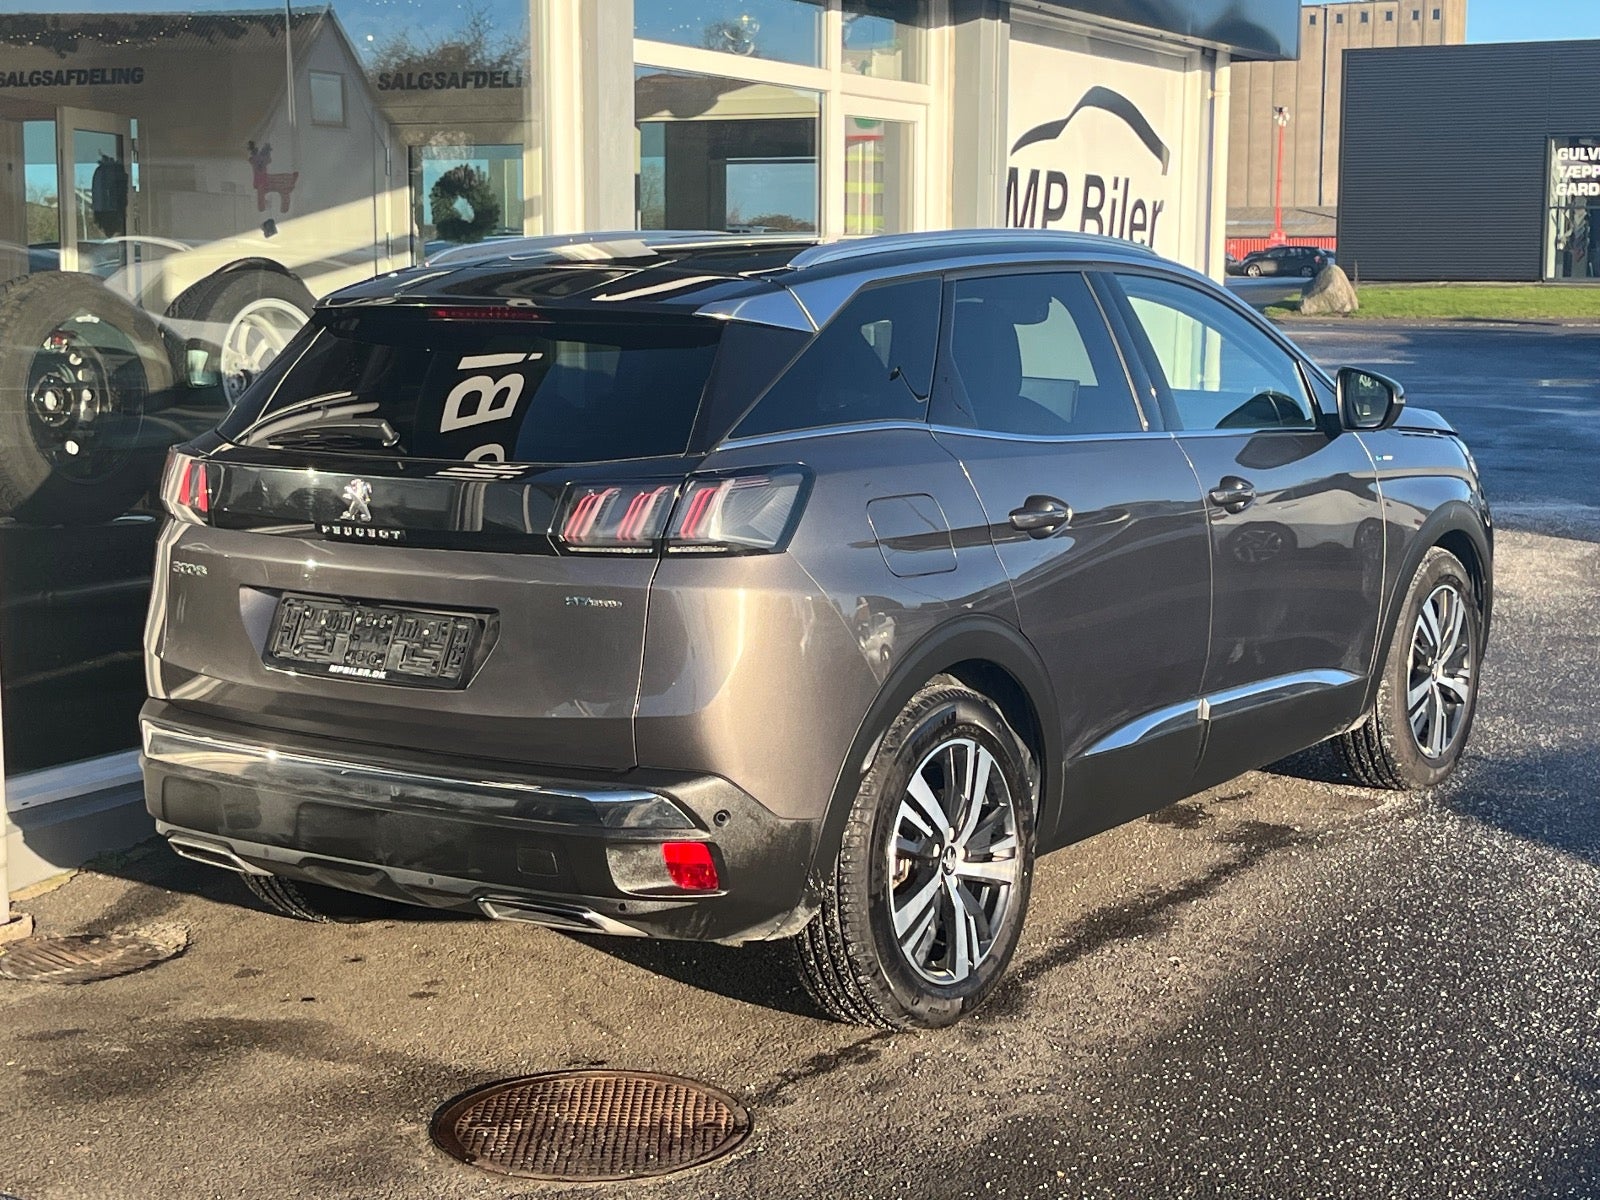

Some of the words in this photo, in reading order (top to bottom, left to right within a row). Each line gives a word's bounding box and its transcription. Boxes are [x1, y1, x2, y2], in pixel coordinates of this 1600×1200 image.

[1557, 147, 1600, 161] GULV
[1006, 166, 1068, 229] MP
[1080, 173, 1164, 249] Biler
[321, 524, 401, 540] PEUGEOT
[328, 664, 387, 680] MPBILER.DK
